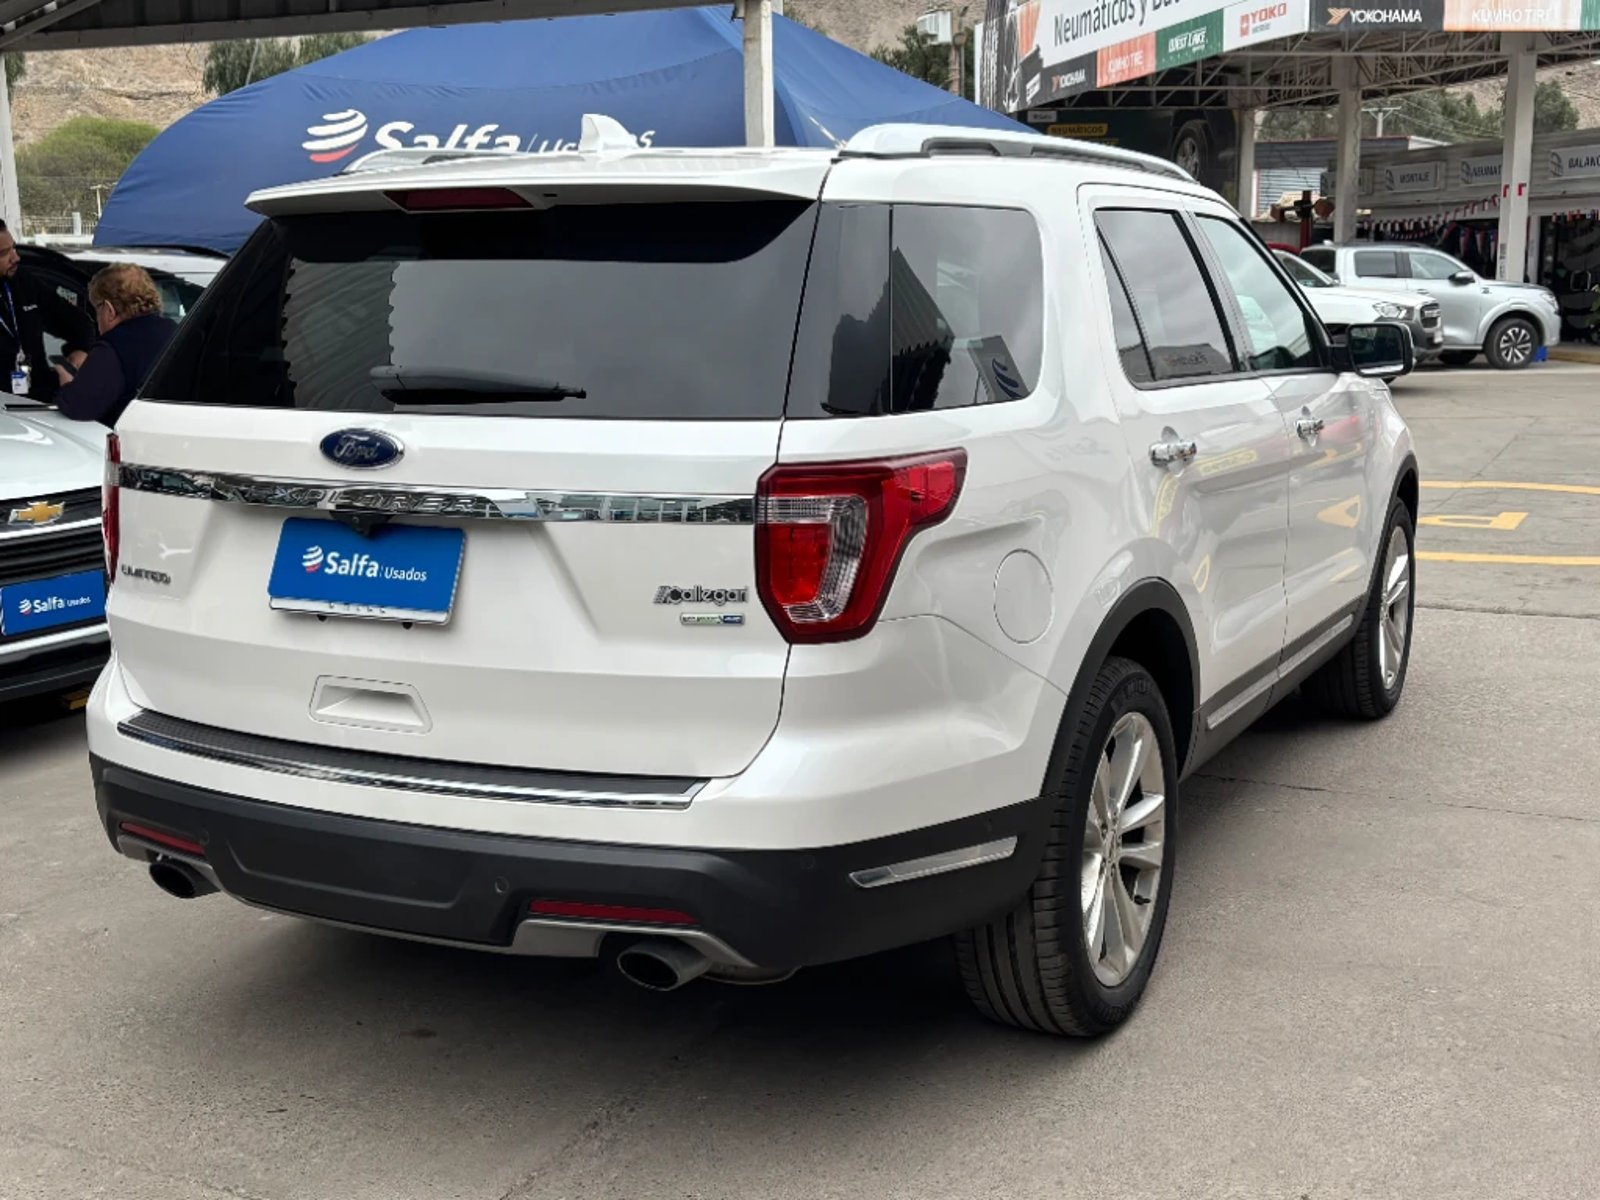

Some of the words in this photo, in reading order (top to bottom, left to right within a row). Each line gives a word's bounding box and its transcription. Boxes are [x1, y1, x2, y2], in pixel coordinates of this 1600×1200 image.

[1250, 3, 1287, 24] YOKO
[1350, 9, 1423, 23] YOKOHAMA
[1471, 8, 1522, 23] KUMHO
[332, 433, 382, 459] Ford
[324, 551, 380, 578] Salfa
[384, 567, 427, 582] Usados
[33, 596, 66, 613] Salfa
